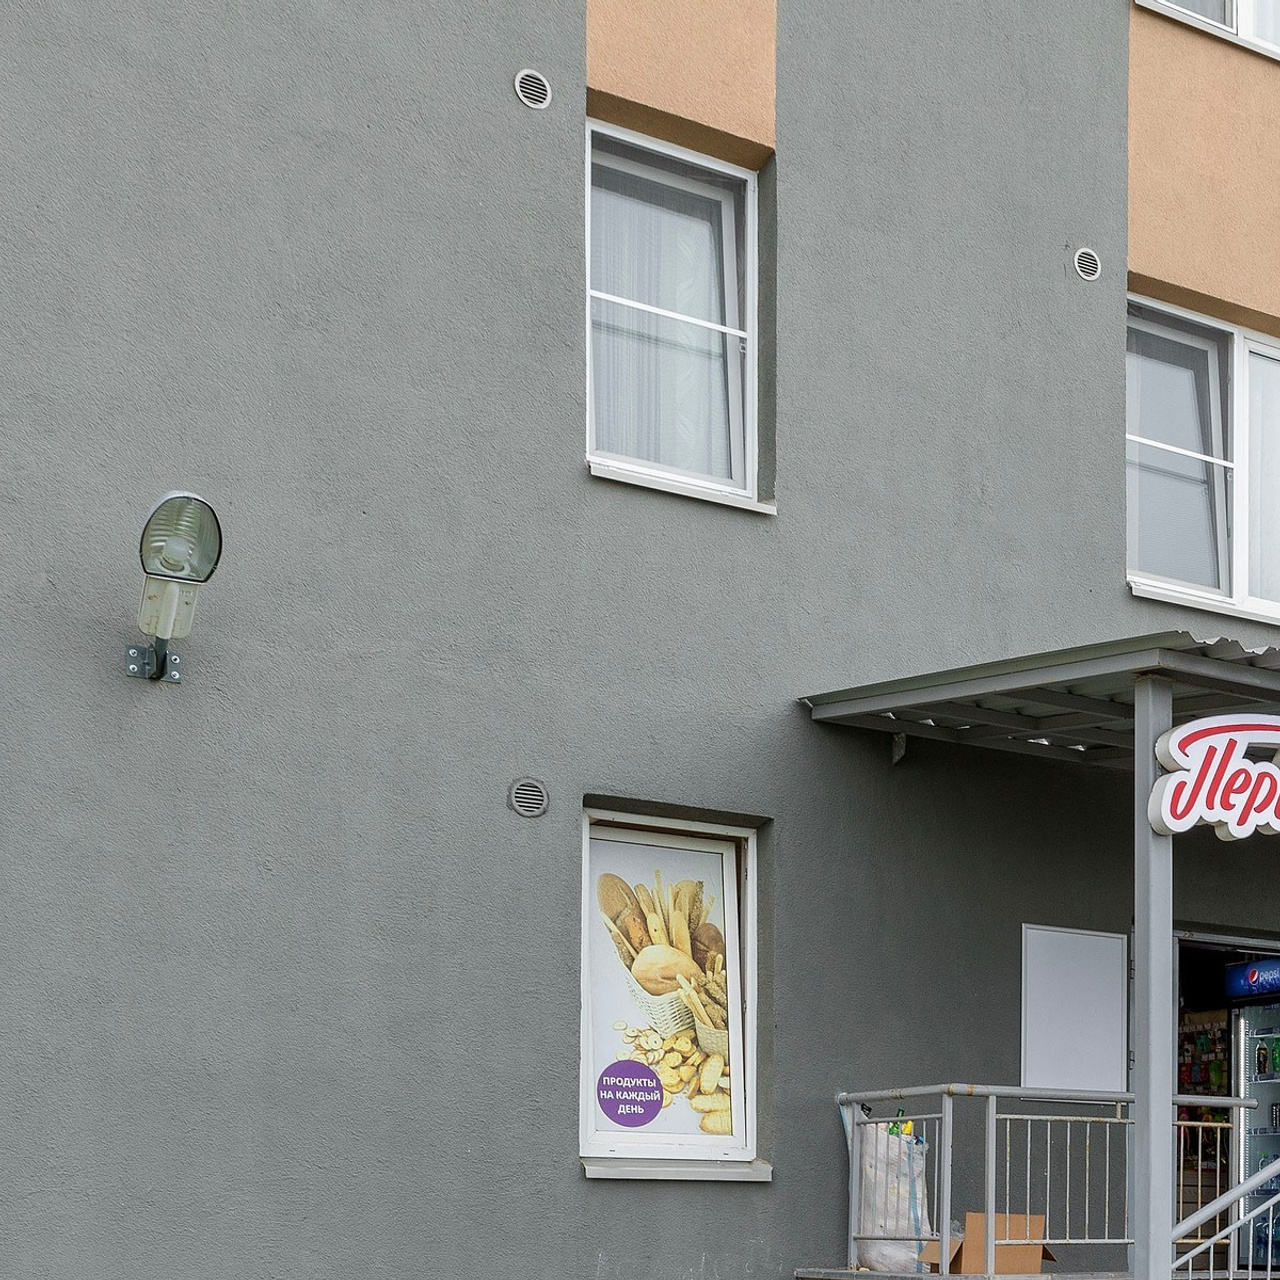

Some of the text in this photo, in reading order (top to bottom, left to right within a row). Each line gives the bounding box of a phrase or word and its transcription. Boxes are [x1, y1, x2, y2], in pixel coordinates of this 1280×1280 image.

[1259, 967, 1280, 983] pepsi
[602, 1076, 657, 1088] ПРОДУКТЫ
[600, 1090, 661, 1102] НА КАЖДЫЙ
[617, 1104, 646, 1115] ДЕНЬ
